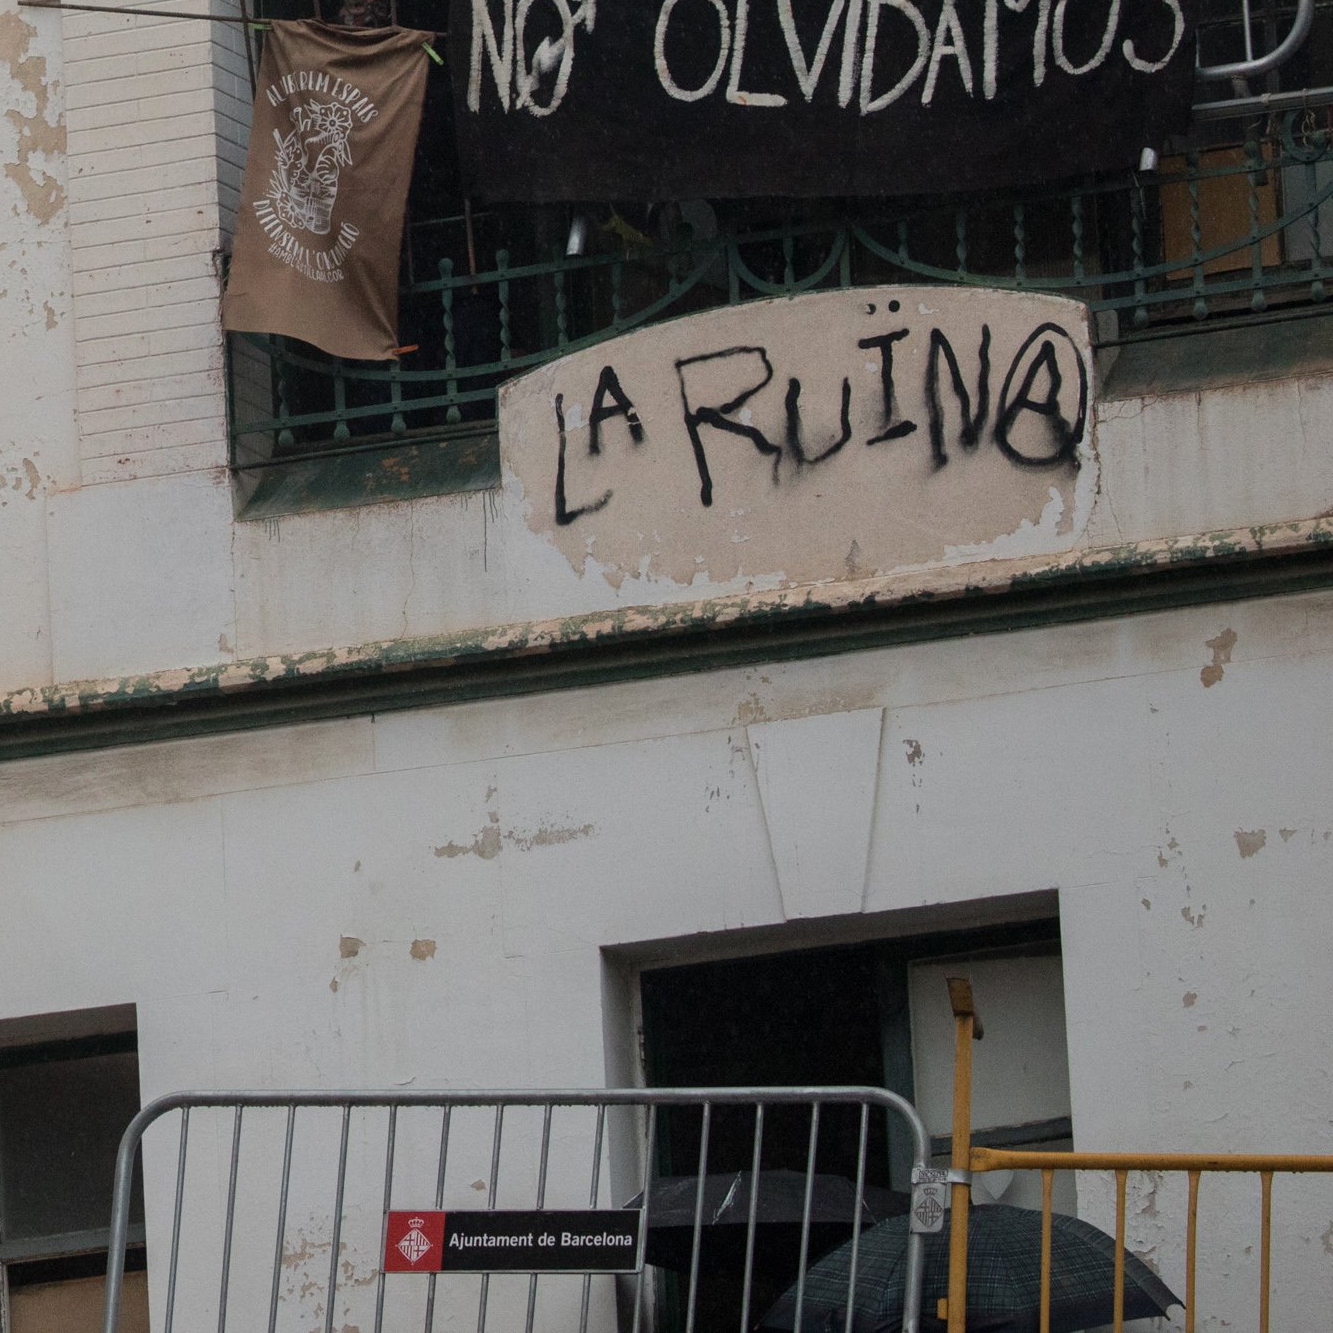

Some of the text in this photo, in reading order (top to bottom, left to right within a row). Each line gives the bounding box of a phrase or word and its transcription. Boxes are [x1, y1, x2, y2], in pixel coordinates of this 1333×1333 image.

[330, 77, 379, 124] ESPAIS
[554, 365, 645, 526] LA
[449, 1230, 633, 1250] Ajuntament de Barcelona
